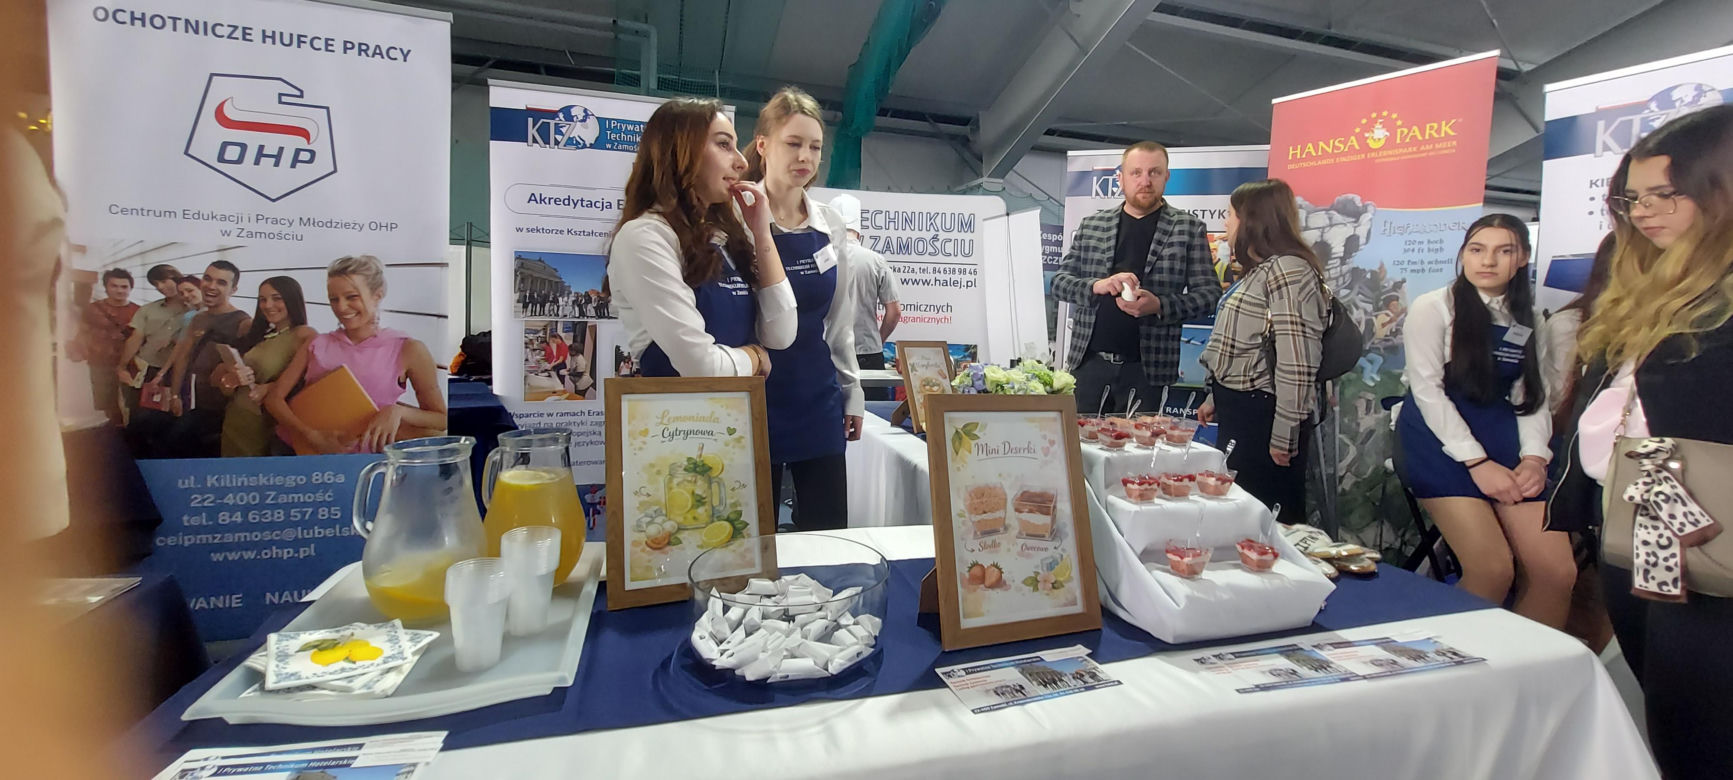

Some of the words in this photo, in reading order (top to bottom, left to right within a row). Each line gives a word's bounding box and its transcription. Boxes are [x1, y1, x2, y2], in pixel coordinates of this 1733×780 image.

[92, 6, 254, 43] OCHOTNICZE
[261, 28, 336, 54] HUFCE
[342, 39, 412, 63] PRACY
[527, 117, 577, 150] KTZ
[611, 120, 645, 132] Prywat
[606, 130, 642, 143] Technik
[1288, 136, 1360, 160] HANSA
[1396, 119, 1458, 144] PARK
[216, 140, 317, 169] OHP
[613, 142, 639, 152] Zamoś
[527, 192, 613, 211] Akredytacja
[108, 204, 178, 220] Centrum
[182, 208, 244, 225] Edukacji
[247, 213, 252, 224] i
[255, 213, 295, 229] Pracy
[299, 215, 365, 233] Młodzieży
[368, 221, 399, 232] OHP
[860, 209, 976, 233] ECHNIKUM
[1182, 209, 1229, 219] ISTYK
[220, 230, 234, 238] w
[237, 226, 304, 242] Zamościu
[526, 226, 565, 235] sektorze
[567, 228, 613, 238] Kształceni
[1041, 231, 1063, 242] espó
[870, 234, 974, 257] ZAMOŚCIU
[889, 266, 901, 274] ka
[902, 266, 917, 274] 22a,
[919, 266, 931, 275] tel.
[932, 267, 942, 275] 84
[944, 267, 956, 275] 638
[900, 277, 977, 289] www.halej.pl
[655, 409, 720, 427] Lemoniada
[1166, 406, 1198, 416] RANSP
[661, 427, 715, 442] Cytrynowa
[974, 442, 999, 457] Mini
[178, 477, 201, 489] ul.
[206, 473, 306, 488] Kilińskiego
[311, 472, 345, 484] 86a
[190, 492, 260, 507] 22-400
[265, 488, 334, 504] Zamość
[182, 512, 213, 526] tel.
[218, 511, 243, 524] 84
[248, 510, 285, 523] 638
[289, 508, 313, 521] 57
[317, 507, 341, 519] 85
[155, 525, 361, 547] ceipmzamosc@lubelsk
[210, 543, 316, 562] www.ohp.pl
[265, 590, 312, 604] NAU
